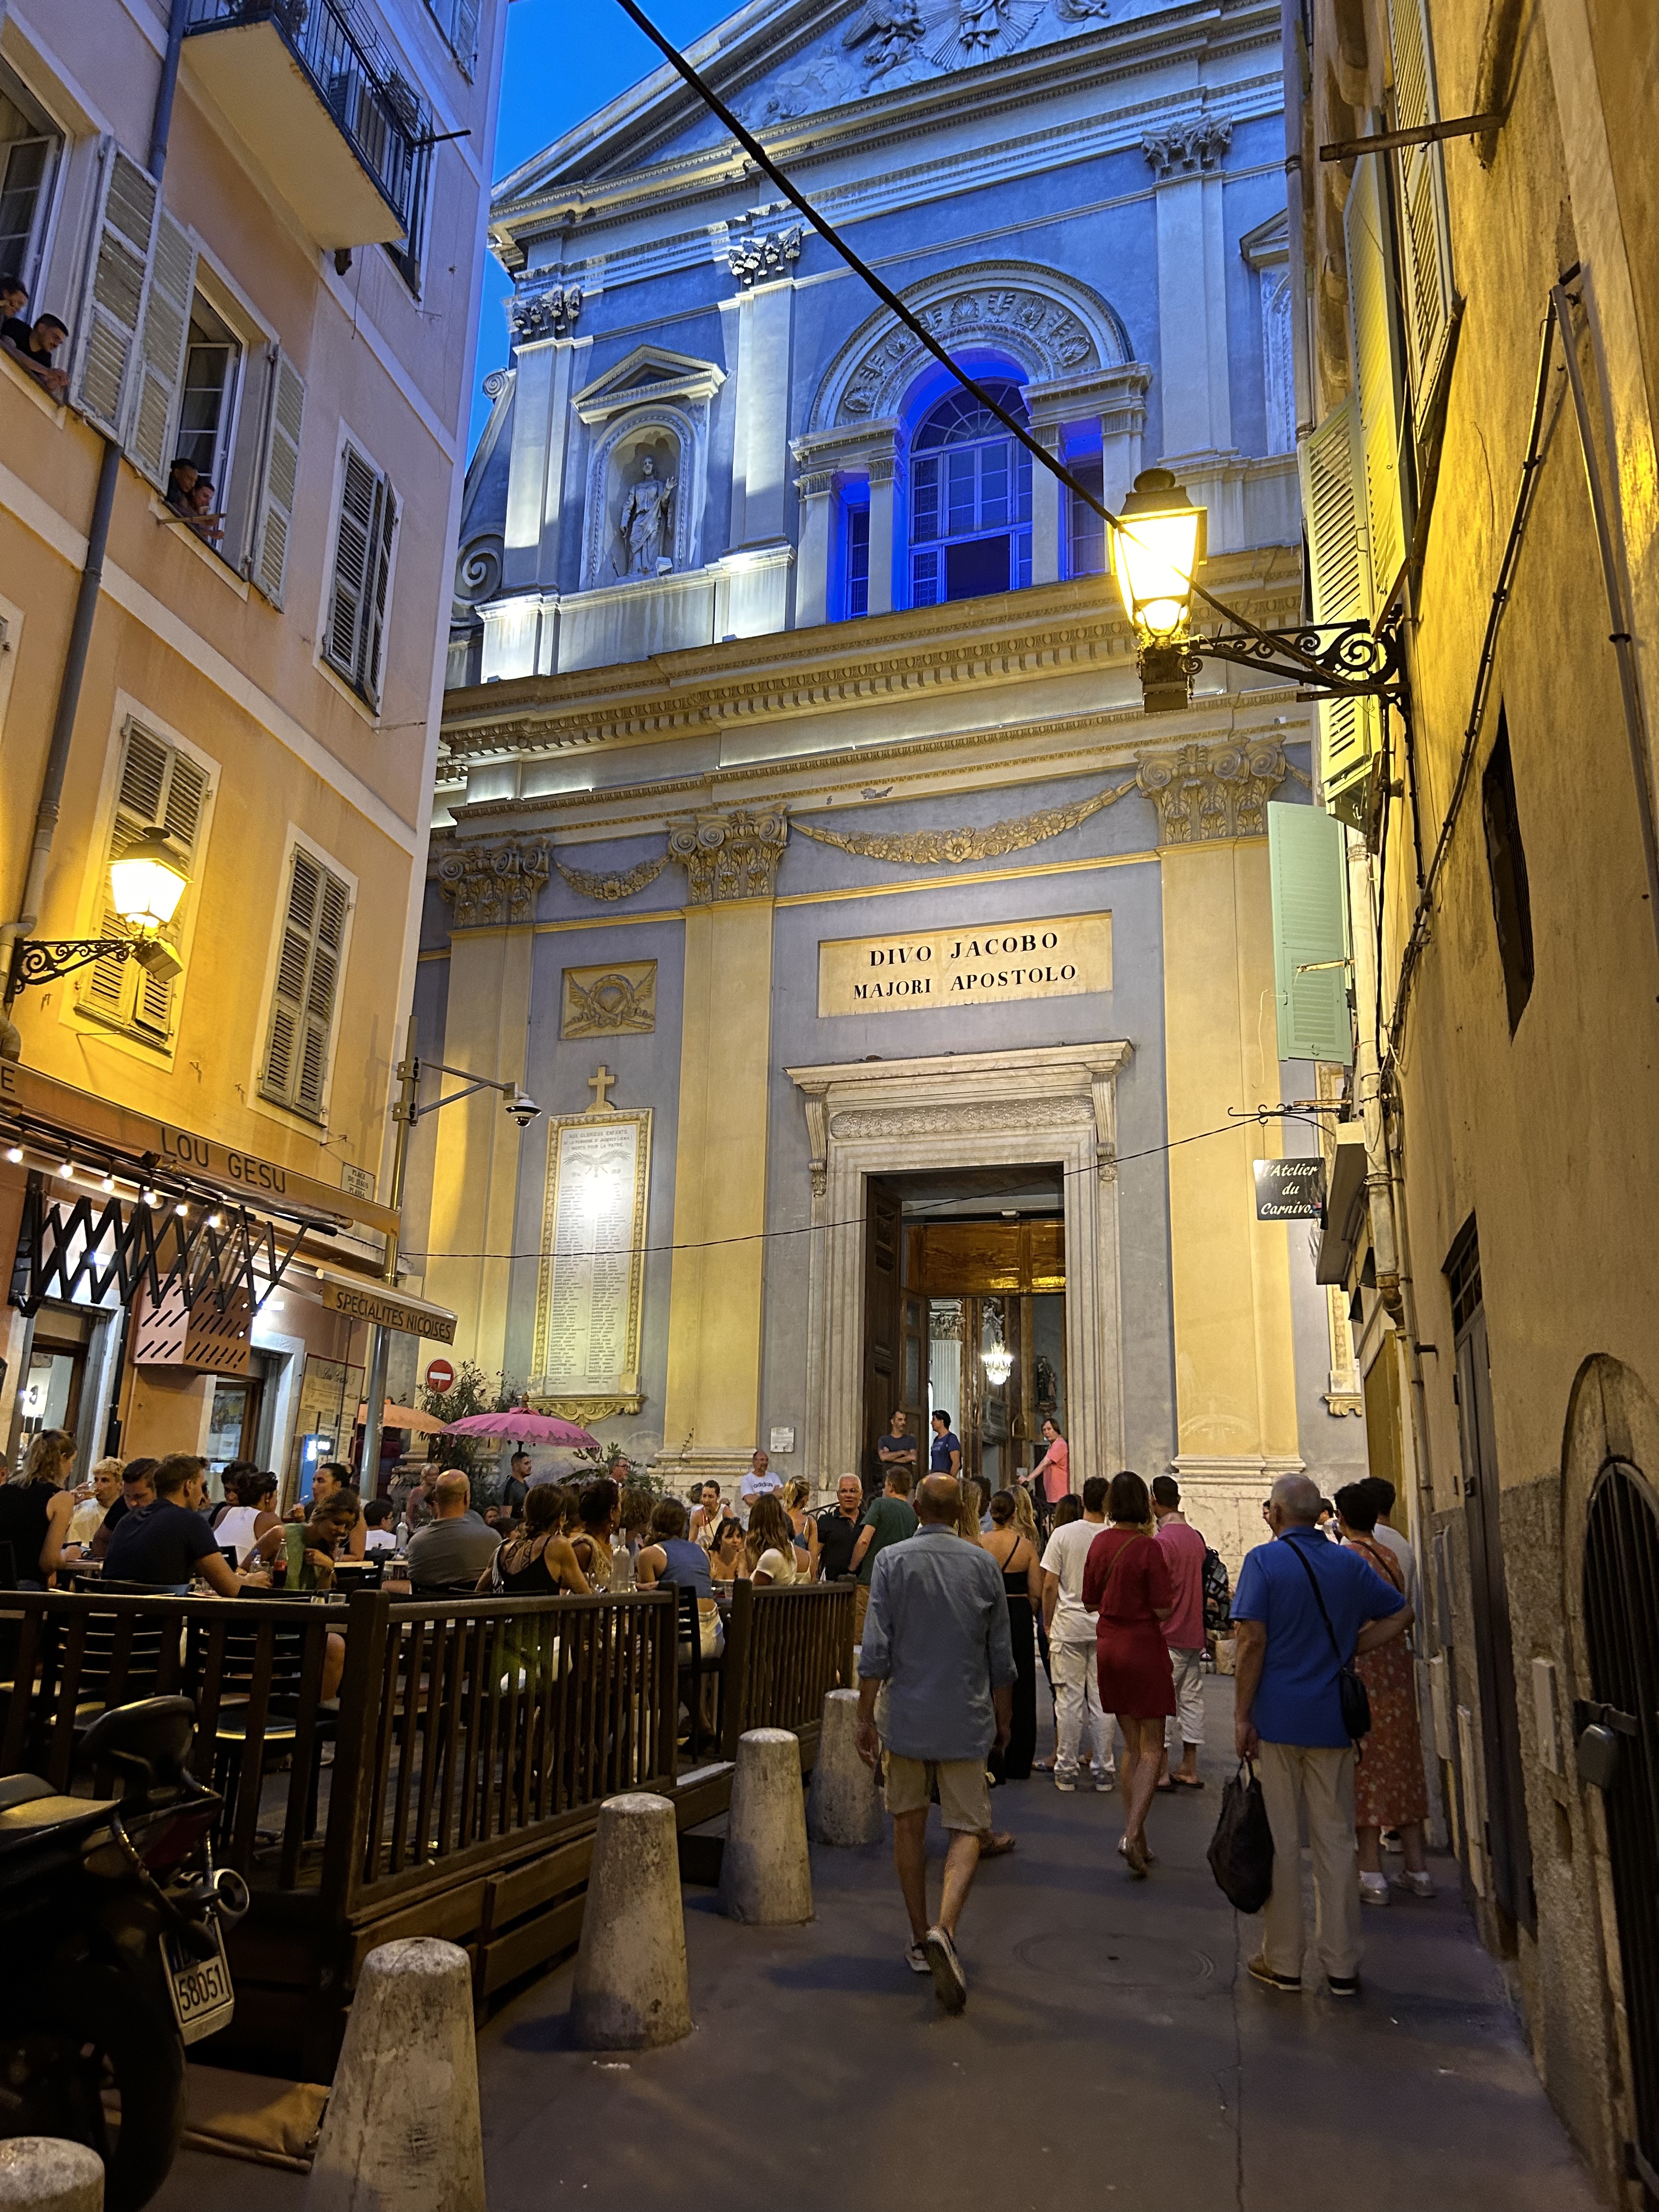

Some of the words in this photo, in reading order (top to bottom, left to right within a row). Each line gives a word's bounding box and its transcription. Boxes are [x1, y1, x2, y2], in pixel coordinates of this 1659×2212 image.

[870, 946, 932, 967] DIVO
[950, 932, 1058, 959] JACOBO
[854, 978, 932, 1000] MAJORI
[950, 964, 1076, 991] APOSTOLO
[161, 1127, 210, 1167] LOU
[228, 1153, 286, 1193] GESU
[352, 1169, 365, 1180] PLACE
[1282, 1182, 1300, 1195] du
[1261, 1201, 1313, 1215] Carnivo
[179, 1963, 224, 2011] 58051
